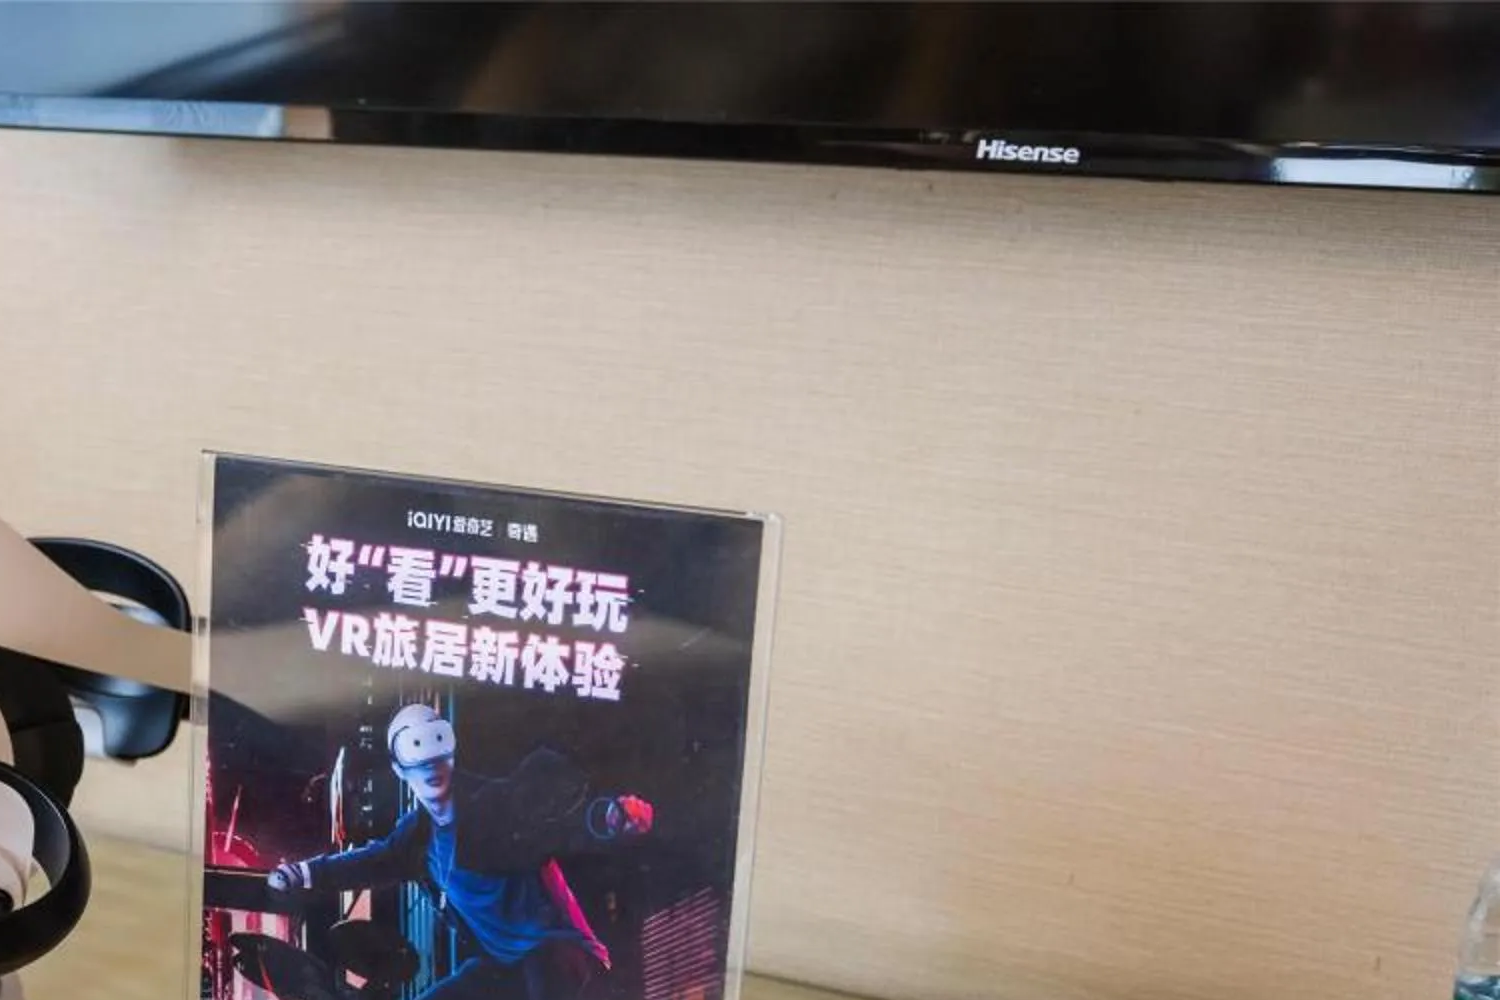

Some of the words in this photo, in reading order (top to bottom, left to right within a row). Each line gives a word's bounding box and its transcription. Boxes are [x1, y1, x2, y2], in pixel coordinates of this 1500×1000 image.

[977, 138, 1080, 164] Hisense
[303, 606, 625, 701] VR旅居新体验
